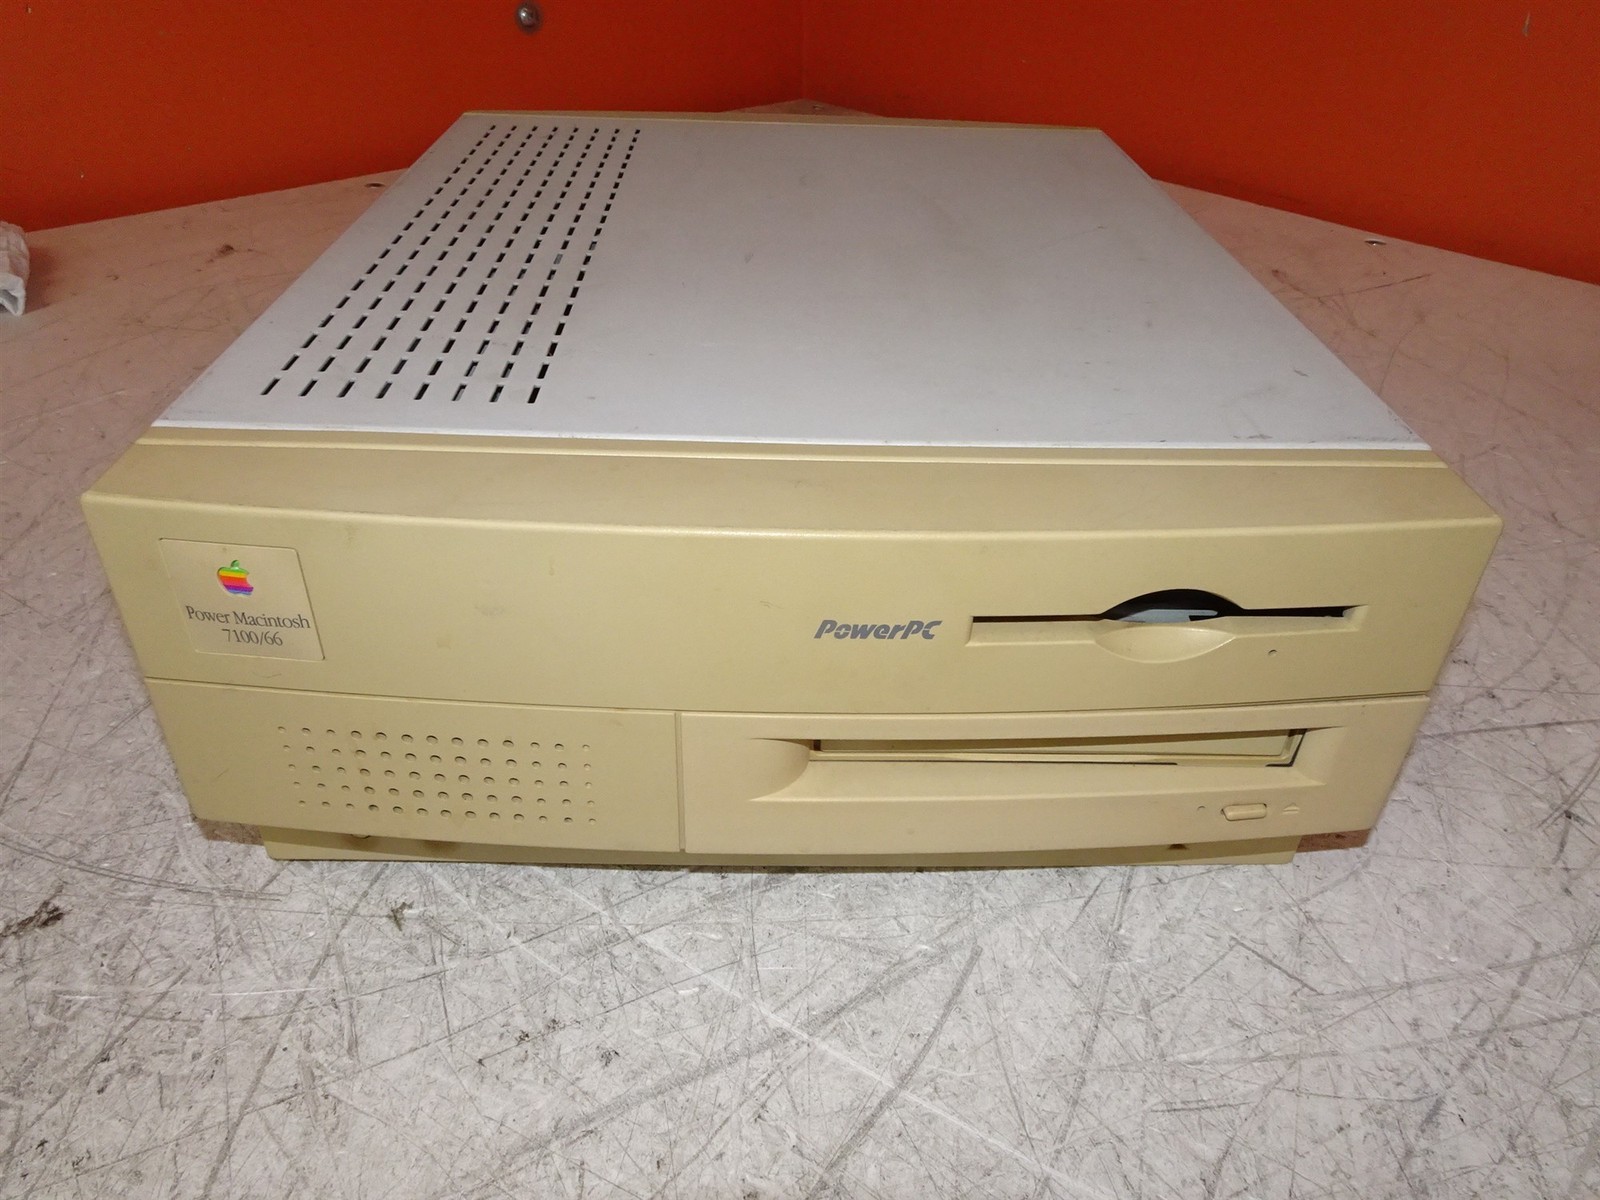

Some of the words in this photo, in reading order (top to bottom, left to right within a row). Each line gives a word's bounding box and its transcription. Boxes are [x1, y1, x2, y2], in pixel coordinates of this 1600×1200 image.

[185, 605, 231, 624] Power
[232, 611, 311, 629] Macintosh
[221, 628, 283, 646] 7100/66
[813, 619, 942, 640] PowerPC
